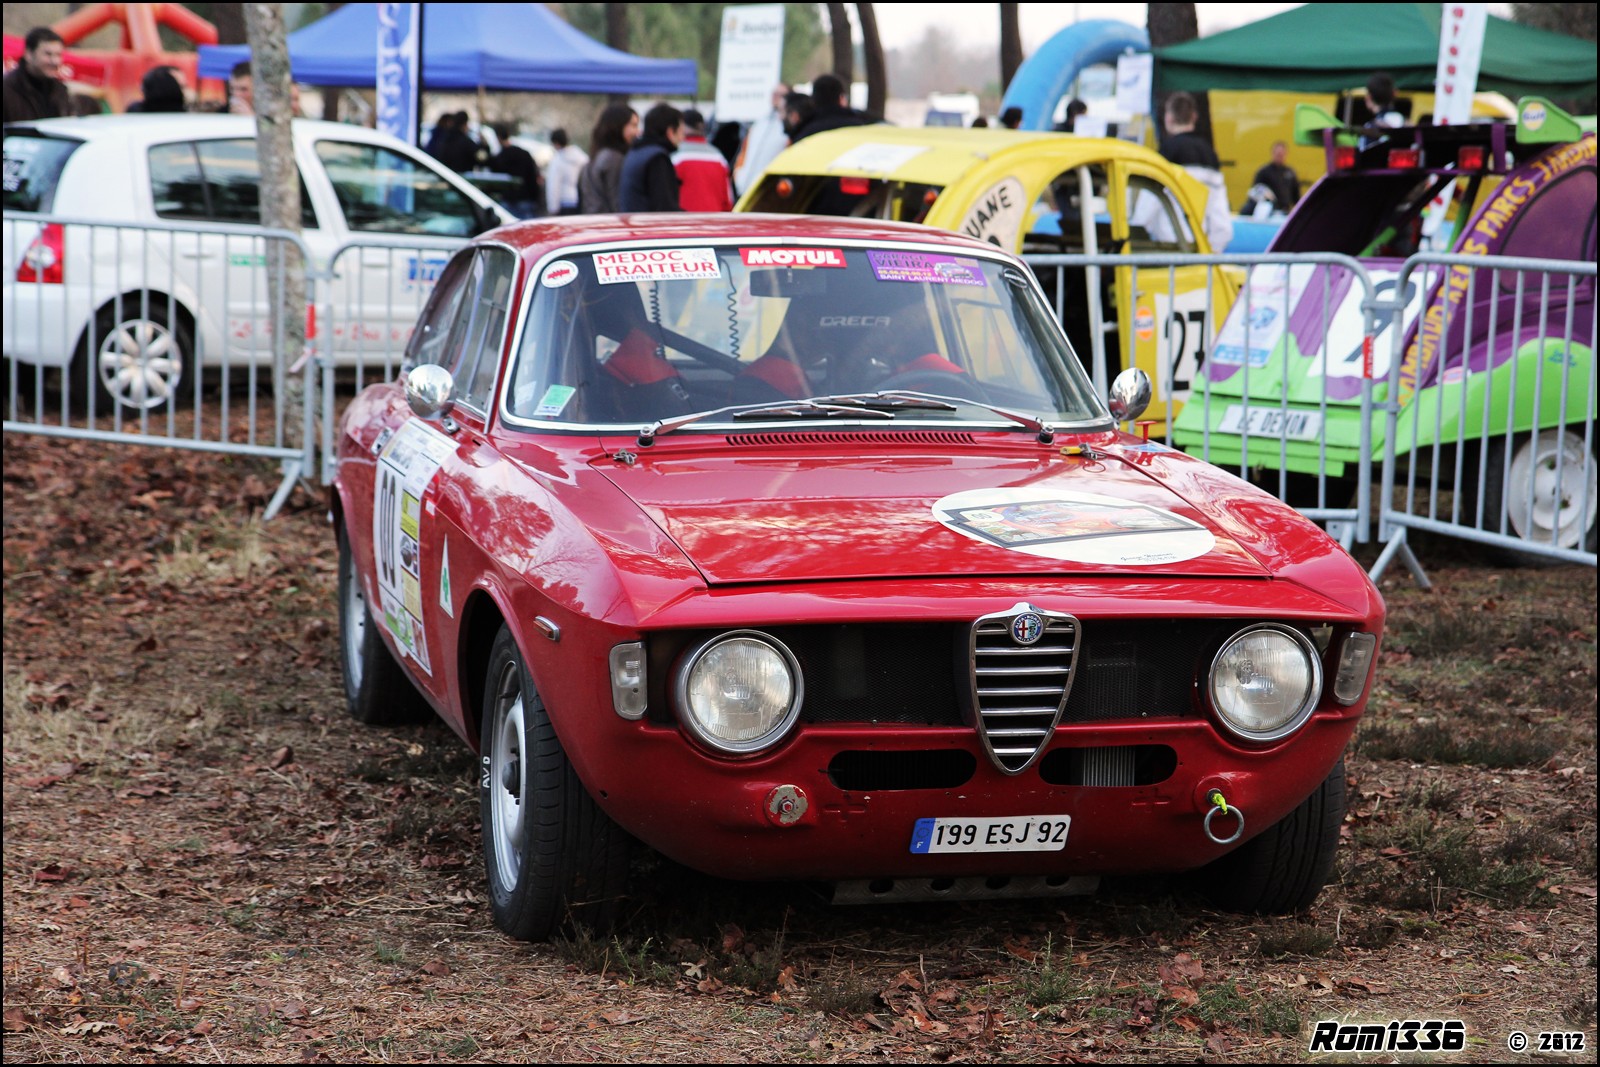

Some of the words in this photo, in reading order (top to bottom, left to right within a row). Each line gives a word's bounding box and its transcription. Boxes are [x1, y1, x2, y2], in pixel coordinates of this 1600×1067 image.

[965, 187, 1012, 239] UANE
[1475, 176, 1535, 239] PARCS
[597, 250, 683, 265] MEDOC
[747, 249, 841, 265] MOTUL
[874, 258, 935, 269] VIEIRA
[600, 262, 716, 277] TRAITEUR
[879, 273, 906, 281] SAINT
[908, 275, 949, 284] LAURENT
[1165, 310, 1205, 392] 27
[936, 824, 978, 846] 199
[985, 822, 1031, 845] ESJ
[1036, 821, 1067, 843] 92
[916, 841, 924, 849] F
